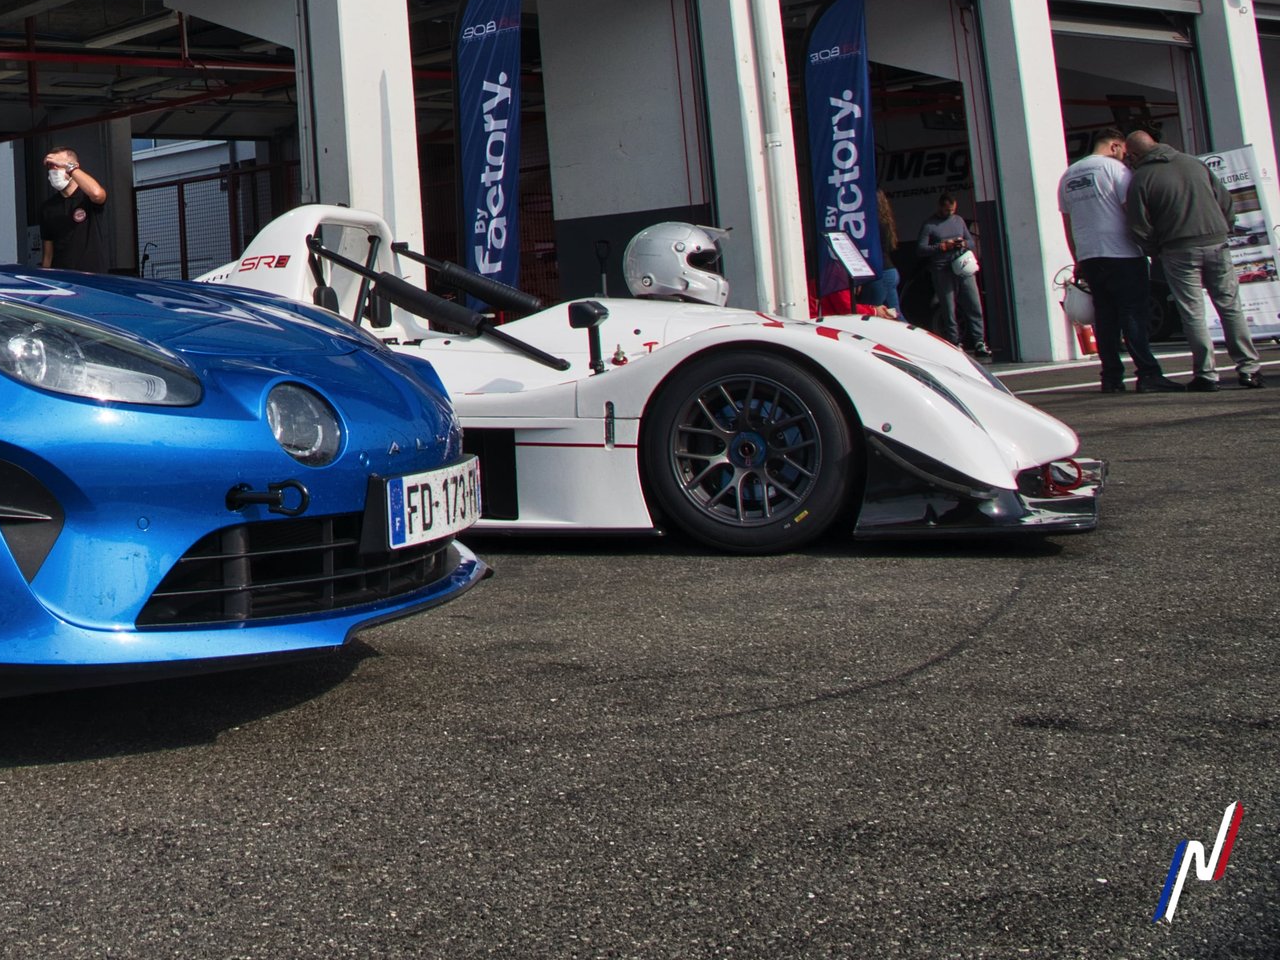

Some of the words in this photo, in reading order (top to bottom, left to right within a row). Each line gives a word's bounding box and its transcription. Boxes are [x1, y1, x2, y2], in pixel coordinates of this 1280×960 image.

[475, 71, 511, 275] Factory.
[828, 90, 867, 240] actory.
[475, 208, 488, 234] By
[825, 205, 838, 228] By
